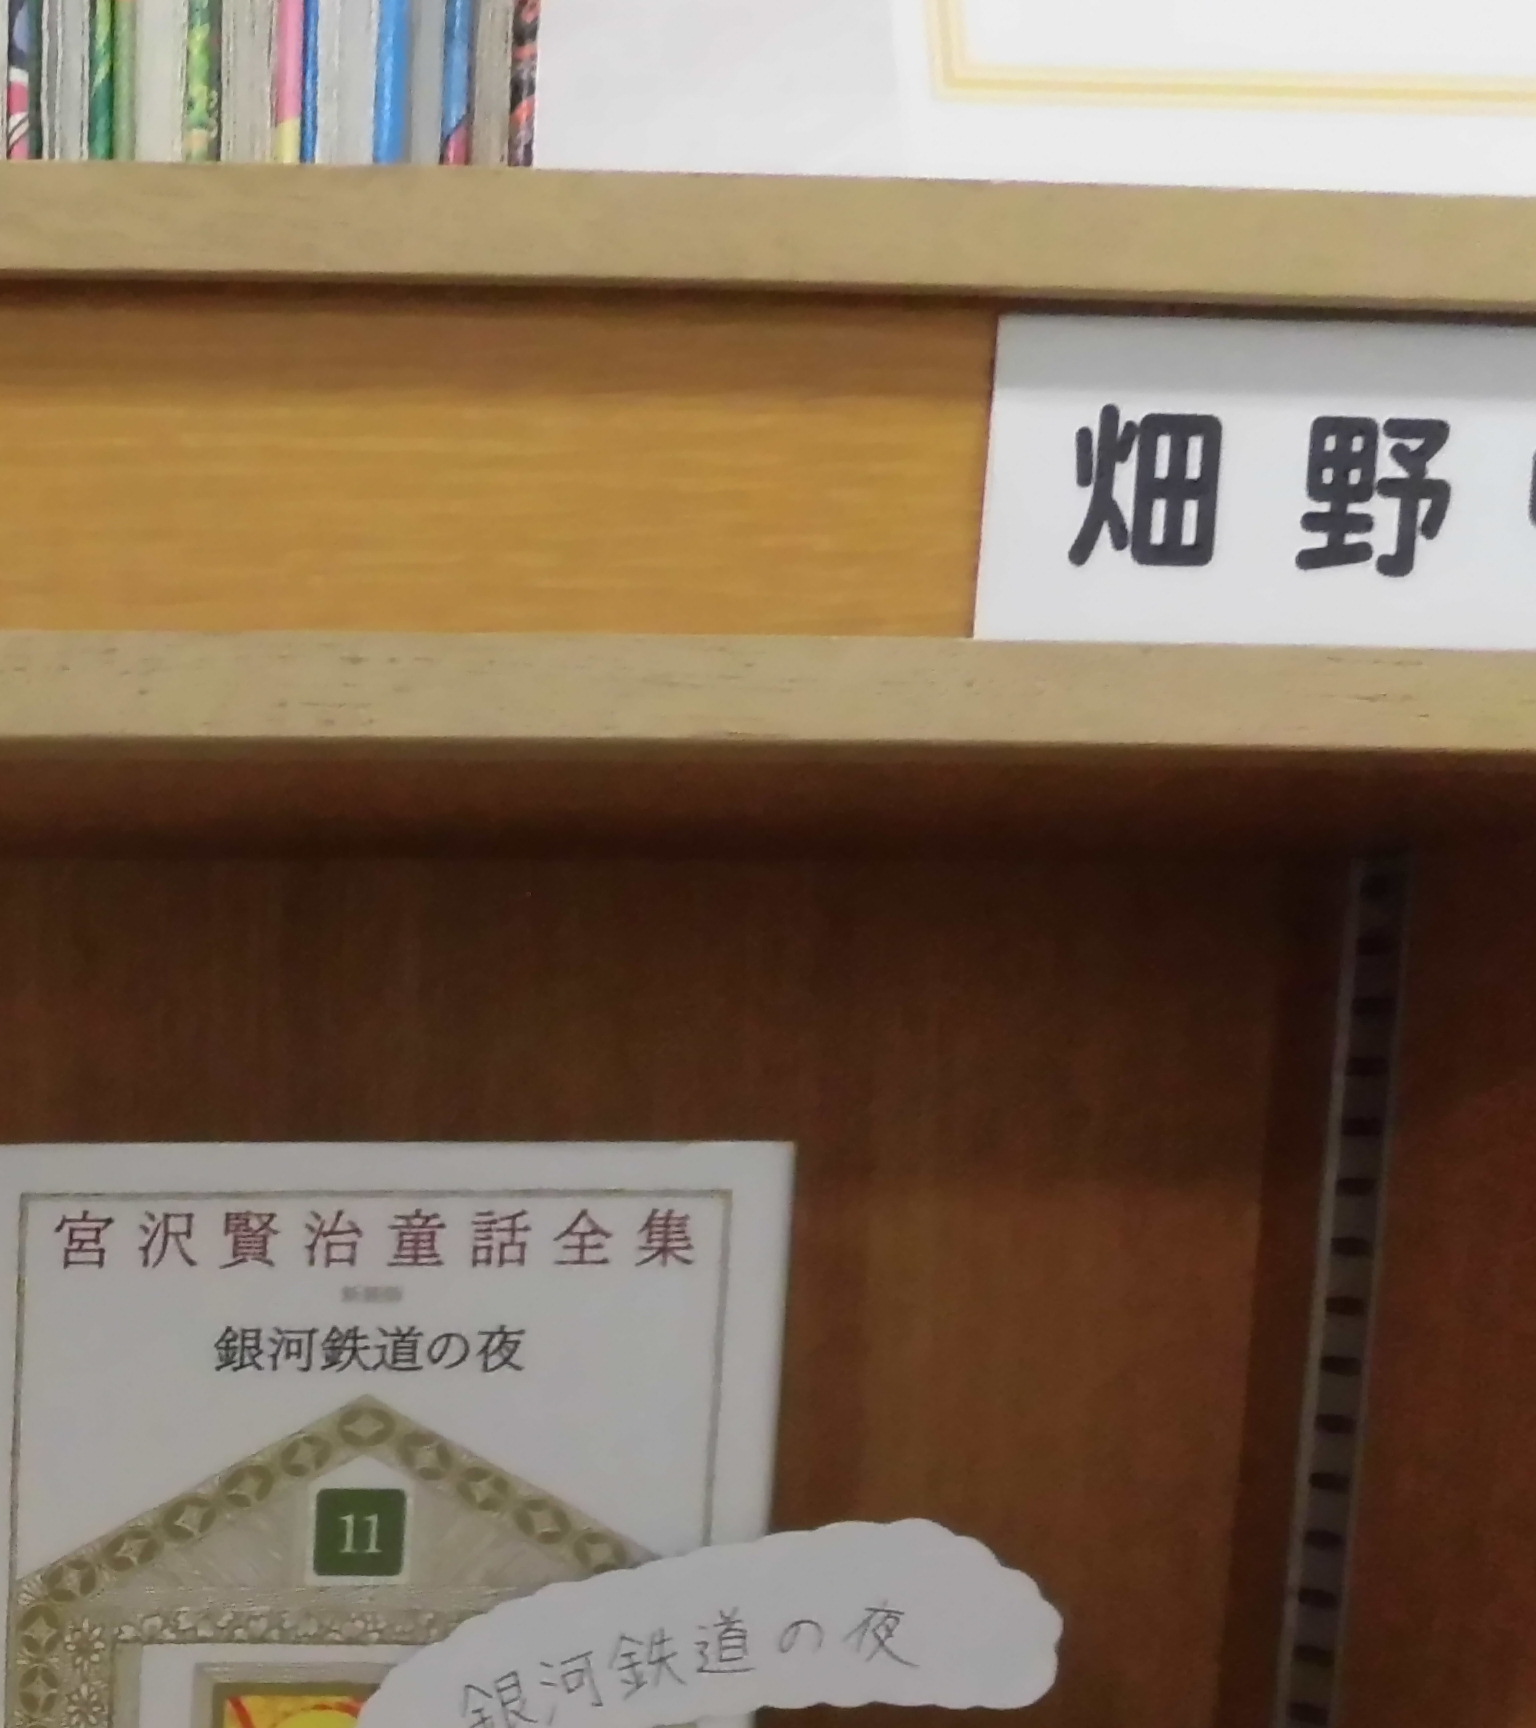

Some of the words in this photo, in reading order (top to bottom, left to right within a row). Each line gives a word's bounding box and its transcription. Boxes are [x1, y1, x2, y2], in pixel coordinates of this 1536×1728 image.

[1068, 404, 1536, 577] 畑野
[52, 1205, 697, 1273] 宮沢賢治童話全集
[214, 1323, 527, 1374] 銀河鉄道の夜
[337, 1512, 383, 1555] 11
